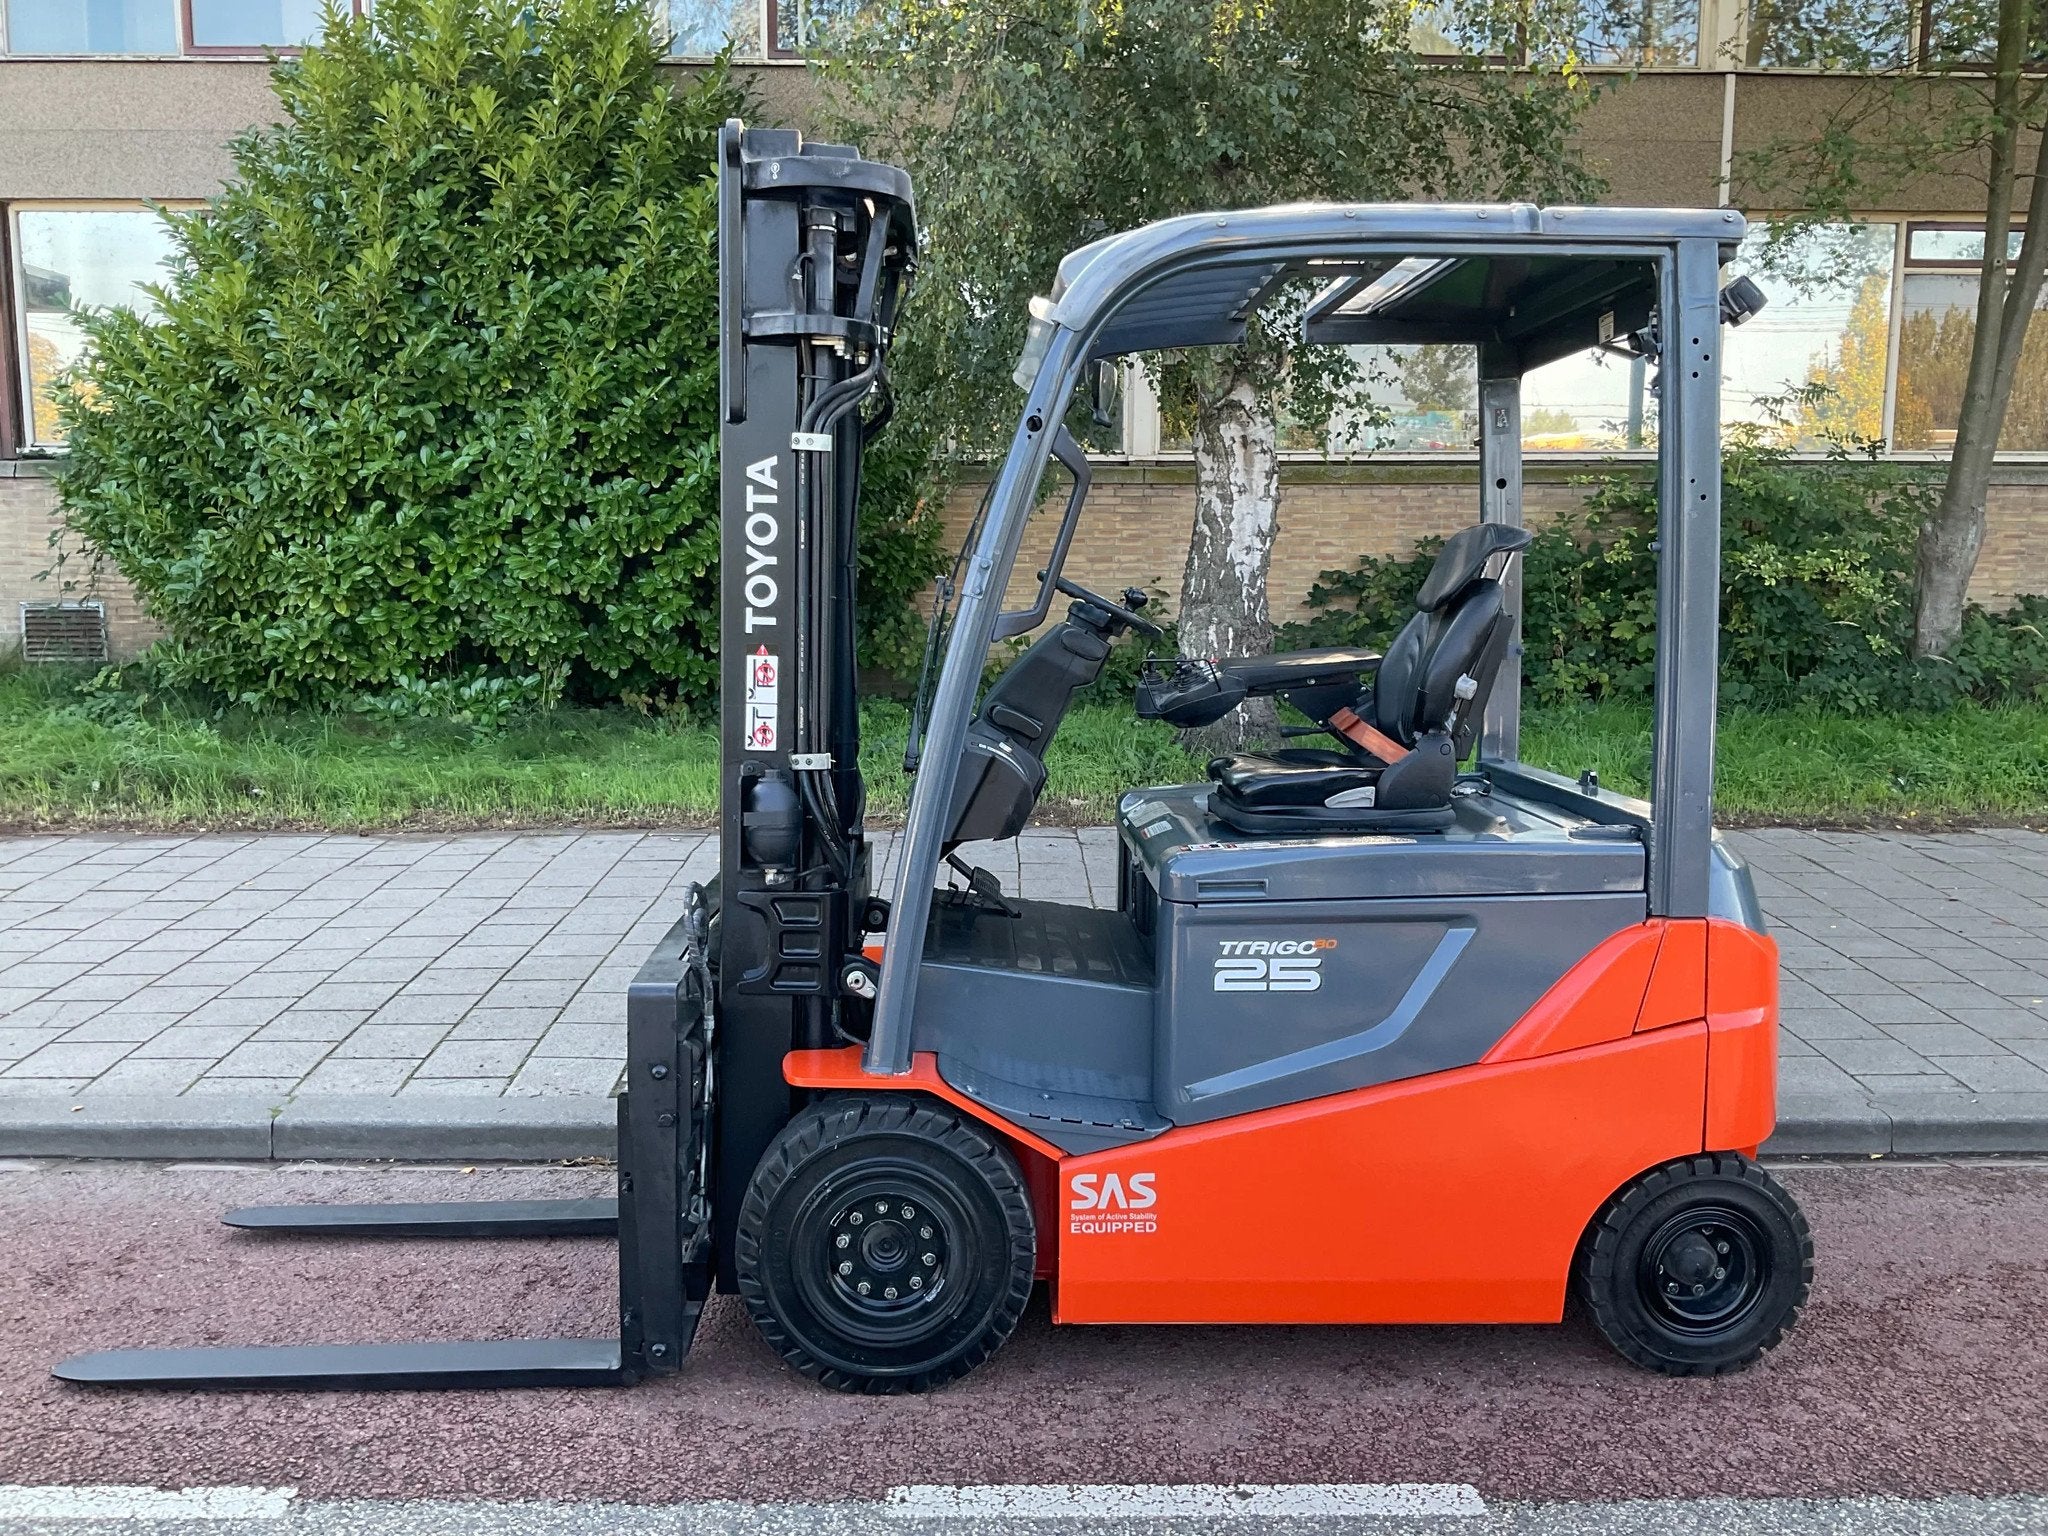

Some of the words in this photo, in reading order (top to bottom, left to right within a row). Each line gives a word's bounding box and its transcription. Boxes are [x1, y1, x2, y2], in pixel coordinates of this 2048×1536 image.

[745, 455, 778, 633] TOYOTA
[1214, 958, 1322, 991] 25
[1071, 1173, 1157, 1209] SAS
[1070, 1213, 1096, 1221] System
[1129, 1212, 1157, 1221] Stability
[1070, 1221, 1157, 1234] EQUIPPED
